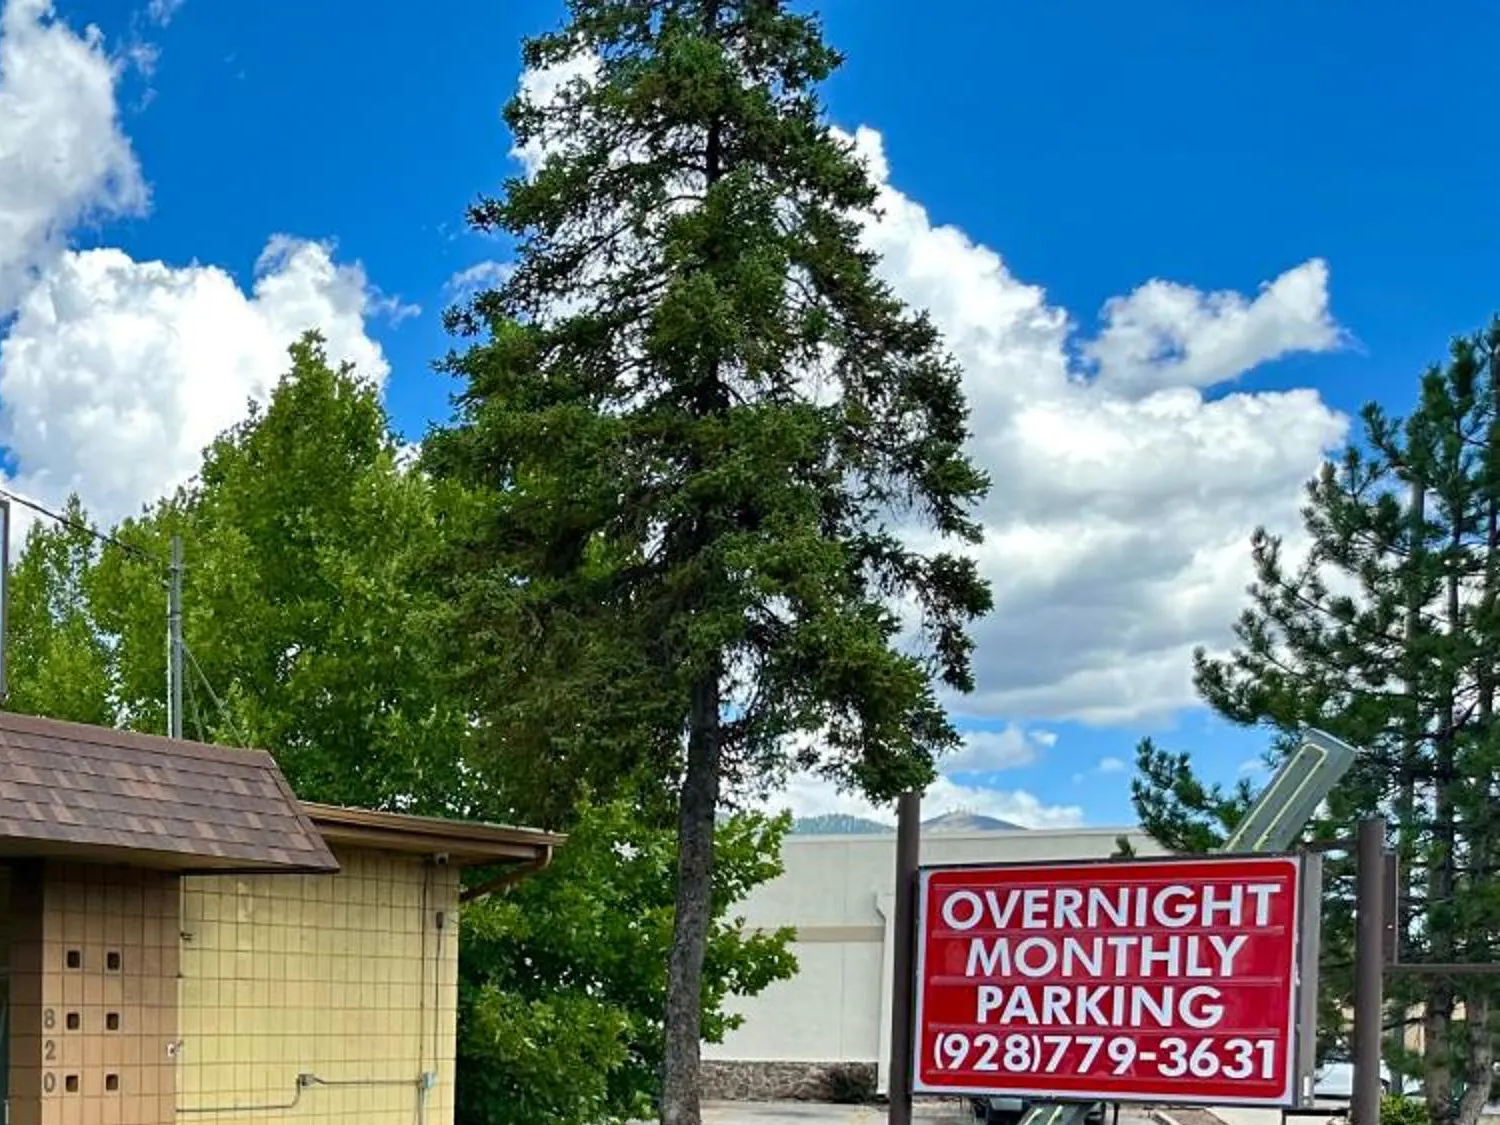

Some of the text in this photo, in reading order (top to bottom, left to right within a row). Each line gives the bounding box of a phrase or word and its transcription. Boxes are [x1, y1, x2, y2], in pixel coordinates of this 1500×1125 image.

[941, 883, 1281, 931] OVERNIGHT
[965, 934, 1249, 978] MONTHLY
[976, 985, 1225, 1029] PARKING
[933, 1032, 1276, 1080] (928)779-3631
